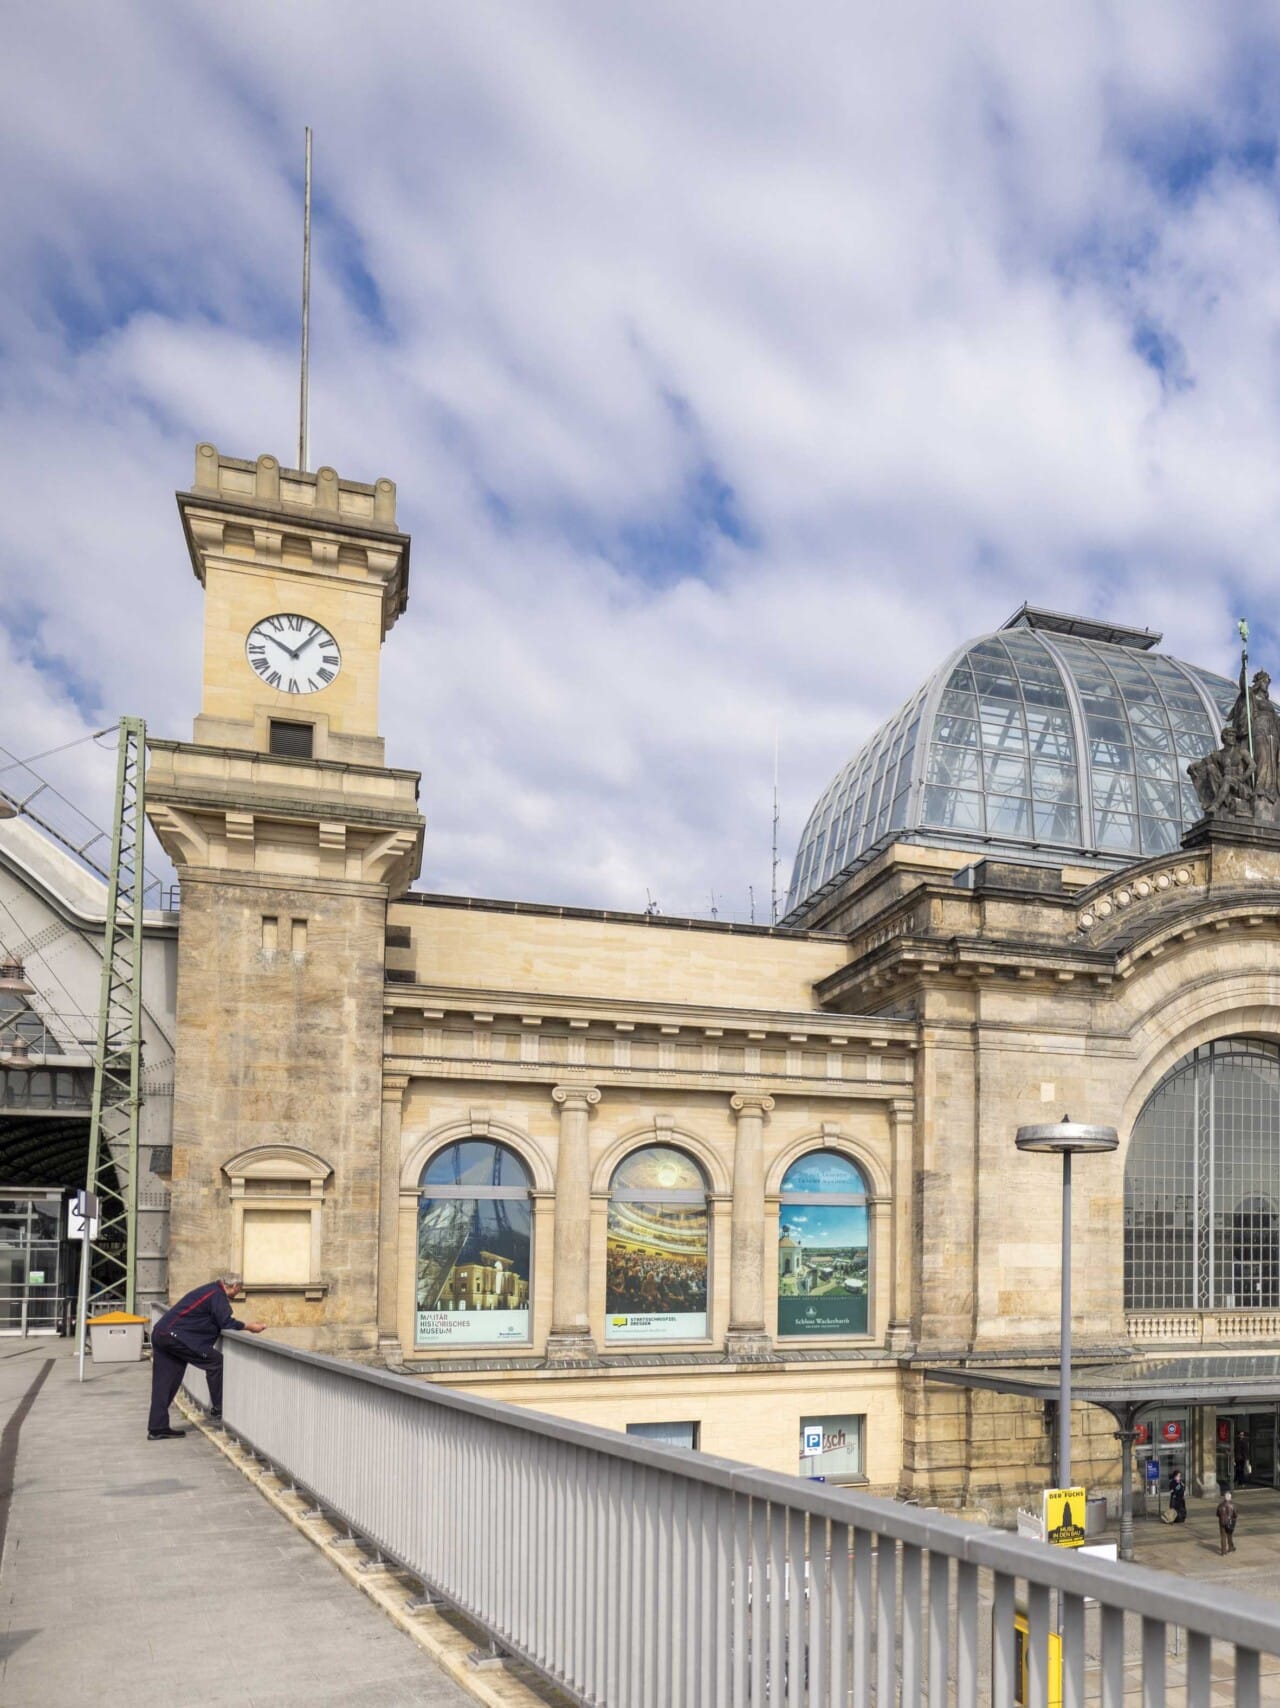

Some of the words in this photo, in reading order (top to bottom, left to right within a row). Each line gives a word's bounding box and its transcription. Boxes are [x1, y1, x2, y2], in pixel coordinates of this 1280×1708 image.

[267, 616, 284, 632] XI
[287, 615, 303, 632] XII
[288, 678, 300, 693] VI
[308, 678, 319, 691] V
[809, 1436, 818, 1447] P
